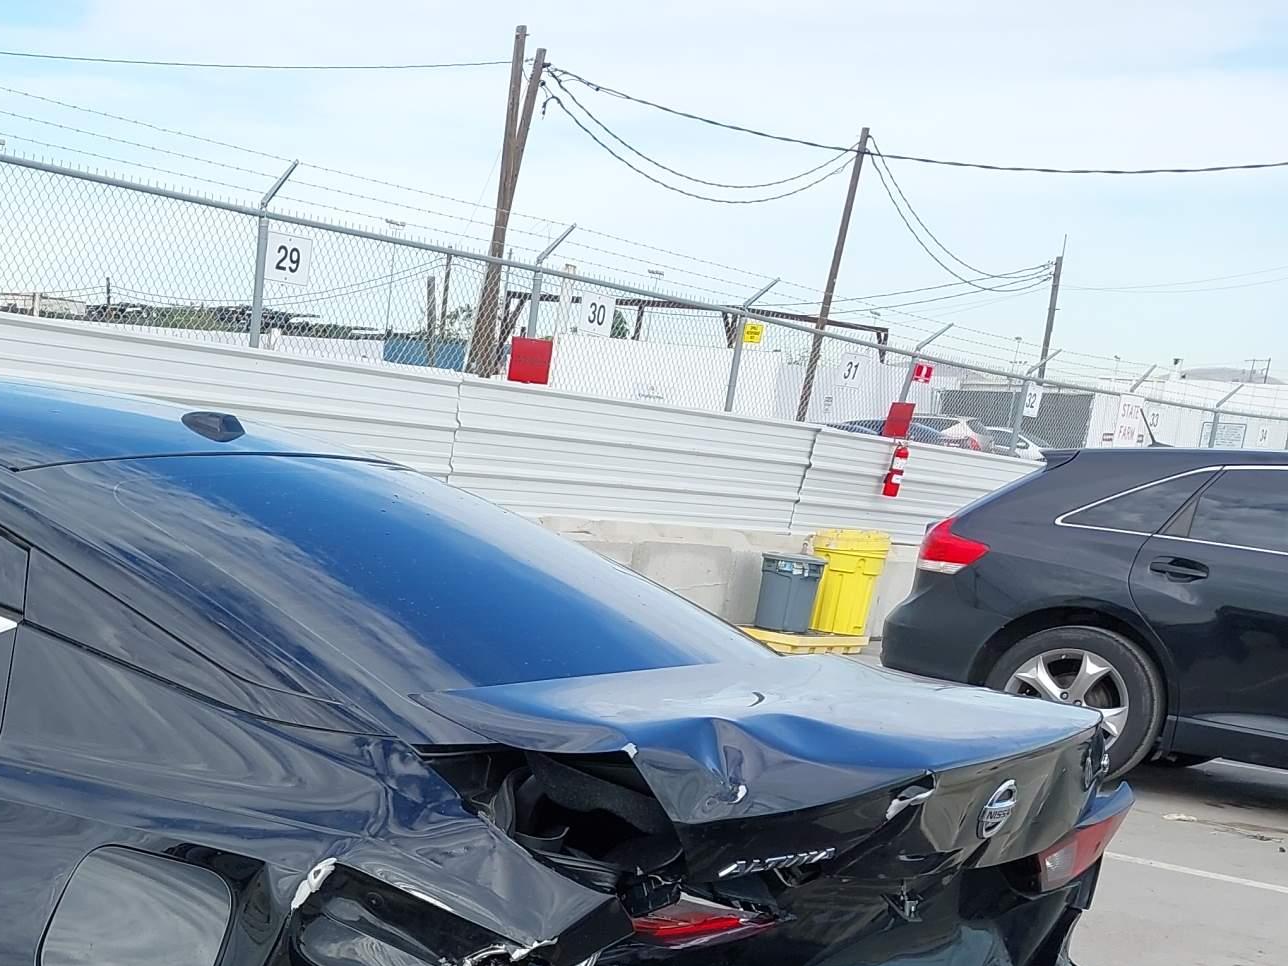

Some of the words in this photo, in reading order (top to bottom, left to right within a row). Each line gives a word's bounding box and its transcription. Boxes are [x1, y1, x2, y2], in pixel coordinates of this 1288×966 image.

[275, 245, 300, 273] 29
[588, 302, 606, 326] 30
[843, 361, 860, 380] 31
[1025, 392, 1037, 409] 32
[1121, 403, 1141, 420] STATE
